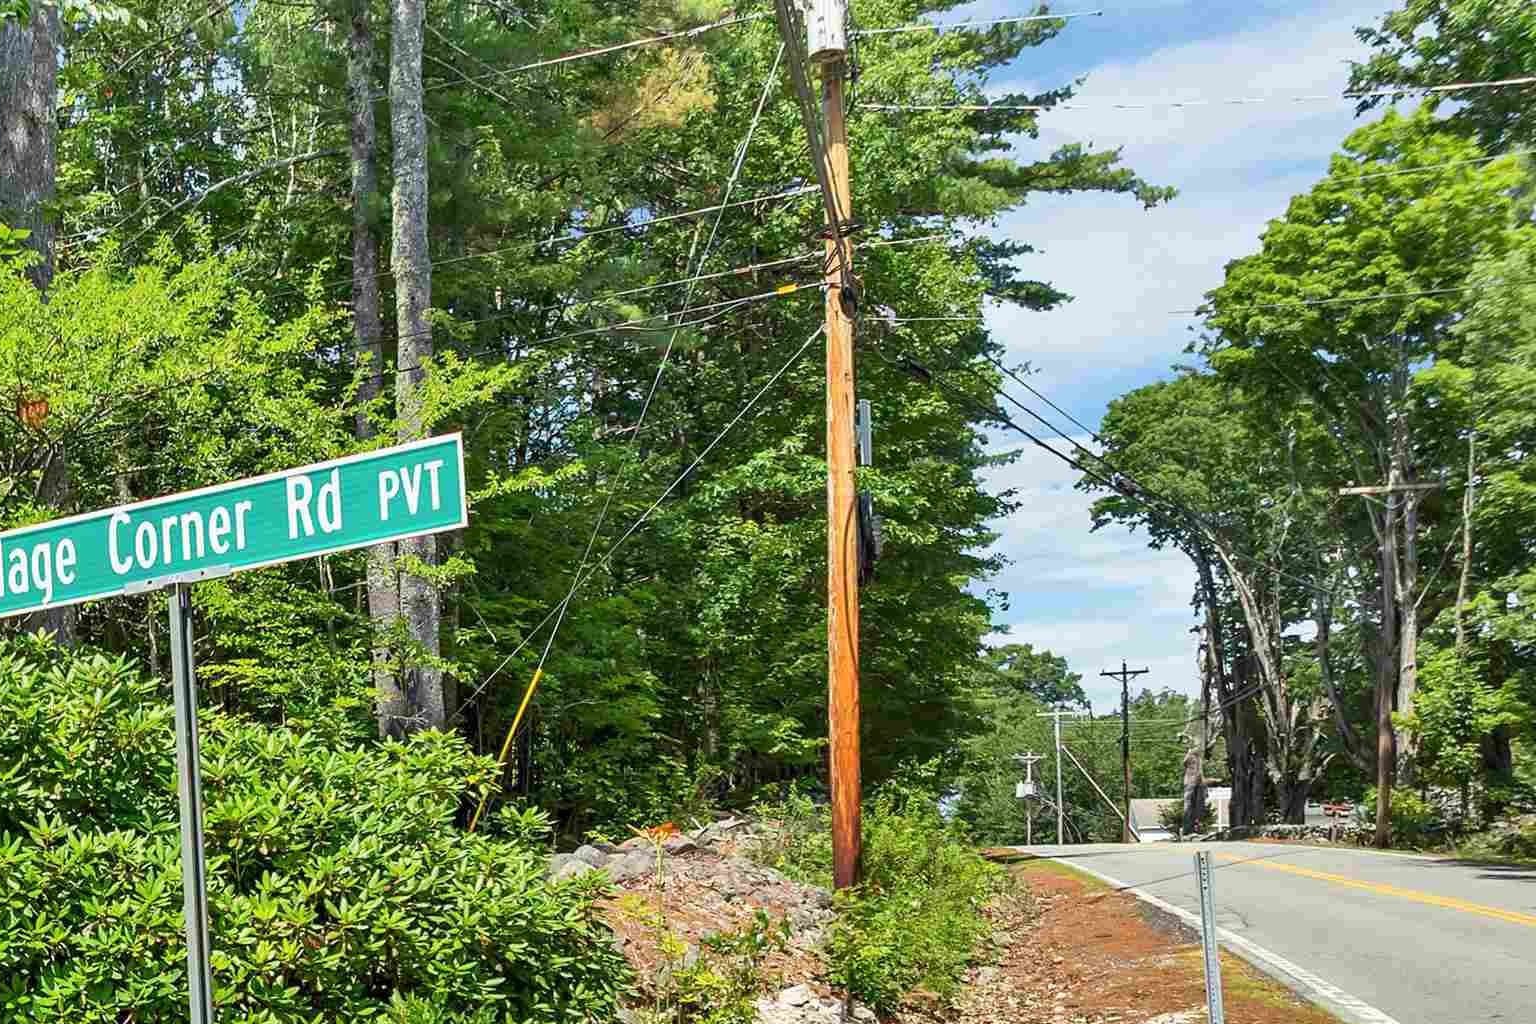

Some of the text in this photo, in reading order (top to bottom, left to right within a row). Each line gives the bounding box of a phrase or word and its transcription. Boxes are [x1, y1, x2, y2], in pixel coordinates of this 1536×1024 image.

[108, 499, 252, 575] Corner
[286, 468, 343, 539] Rd
[379, 460, 444, 521] PVT
